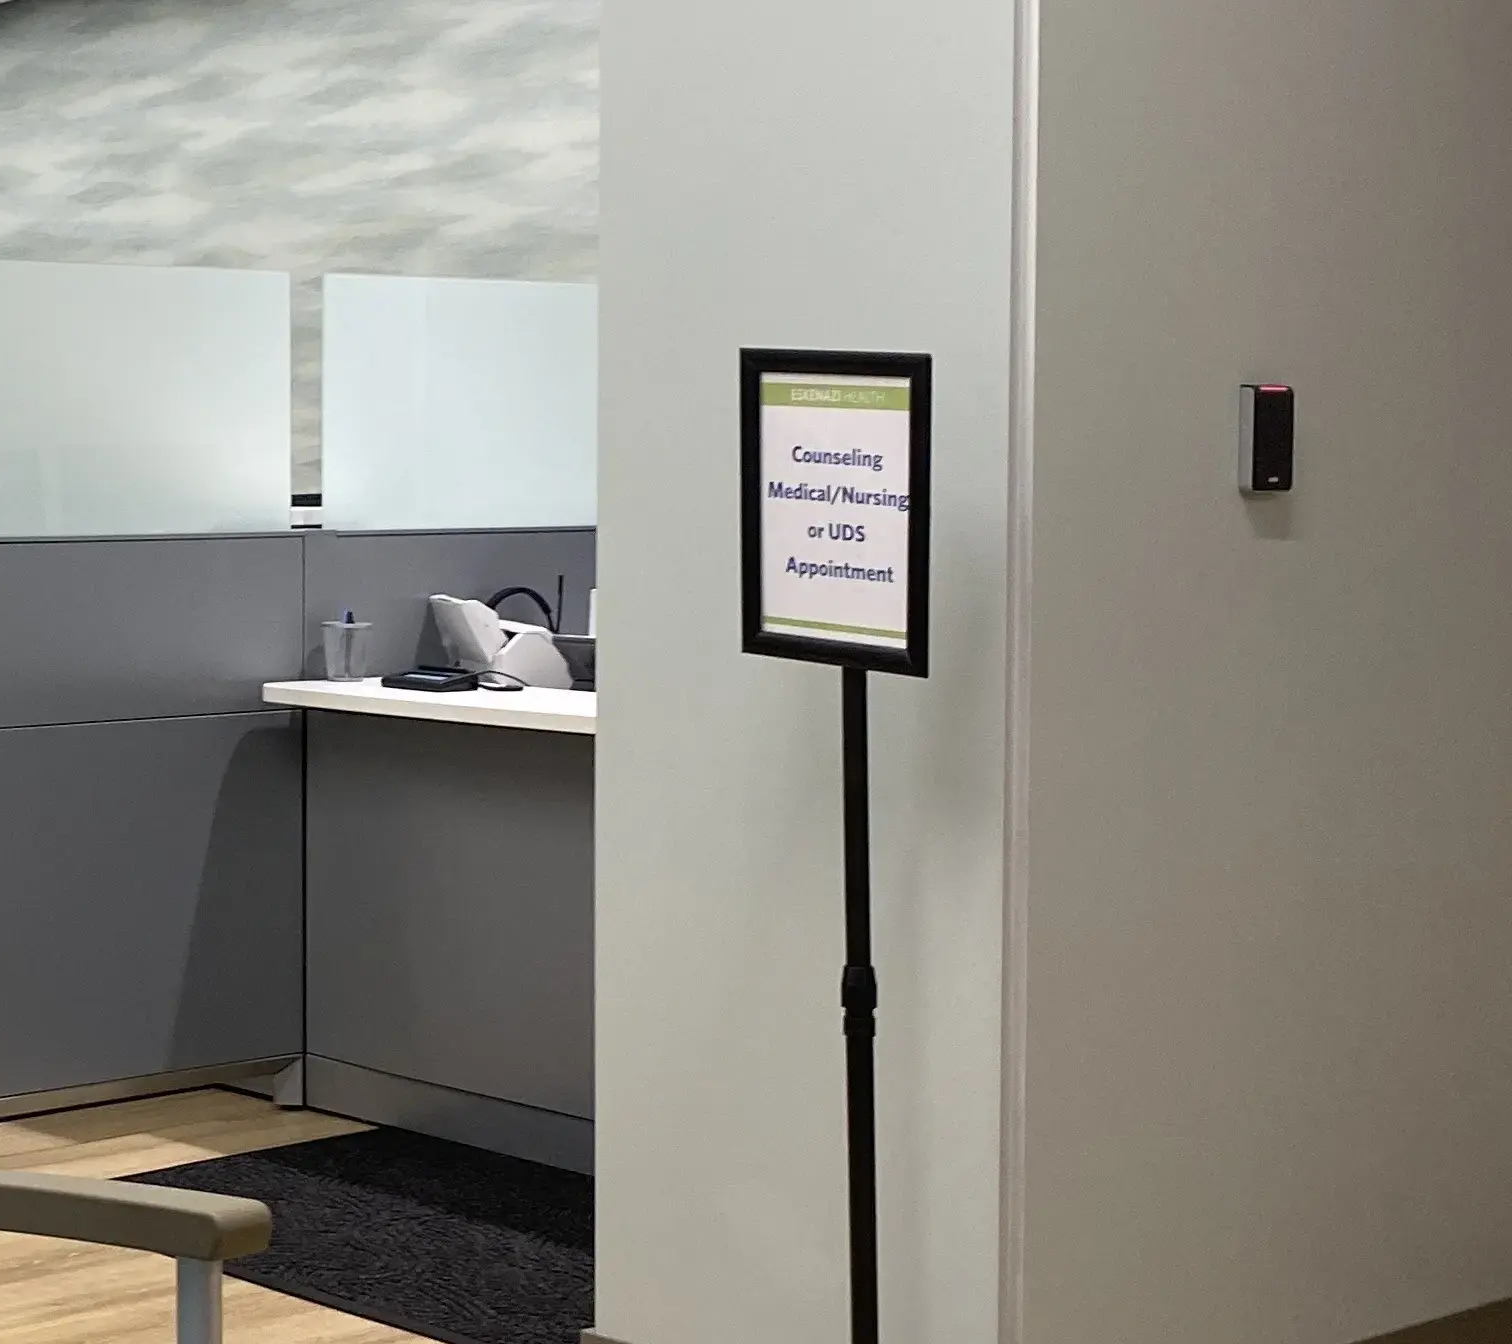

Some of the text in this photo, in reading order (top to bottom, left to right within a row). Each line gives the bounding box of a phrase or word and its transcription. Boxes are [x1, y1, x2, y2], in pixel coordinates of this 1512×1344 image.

[791, 444, 884, 472] Counseling
[767, 481, 910, 512] Medical/Nursing
[807, 523, 865, 542] or UDS
[785, 556, 894, 583] Appointment
